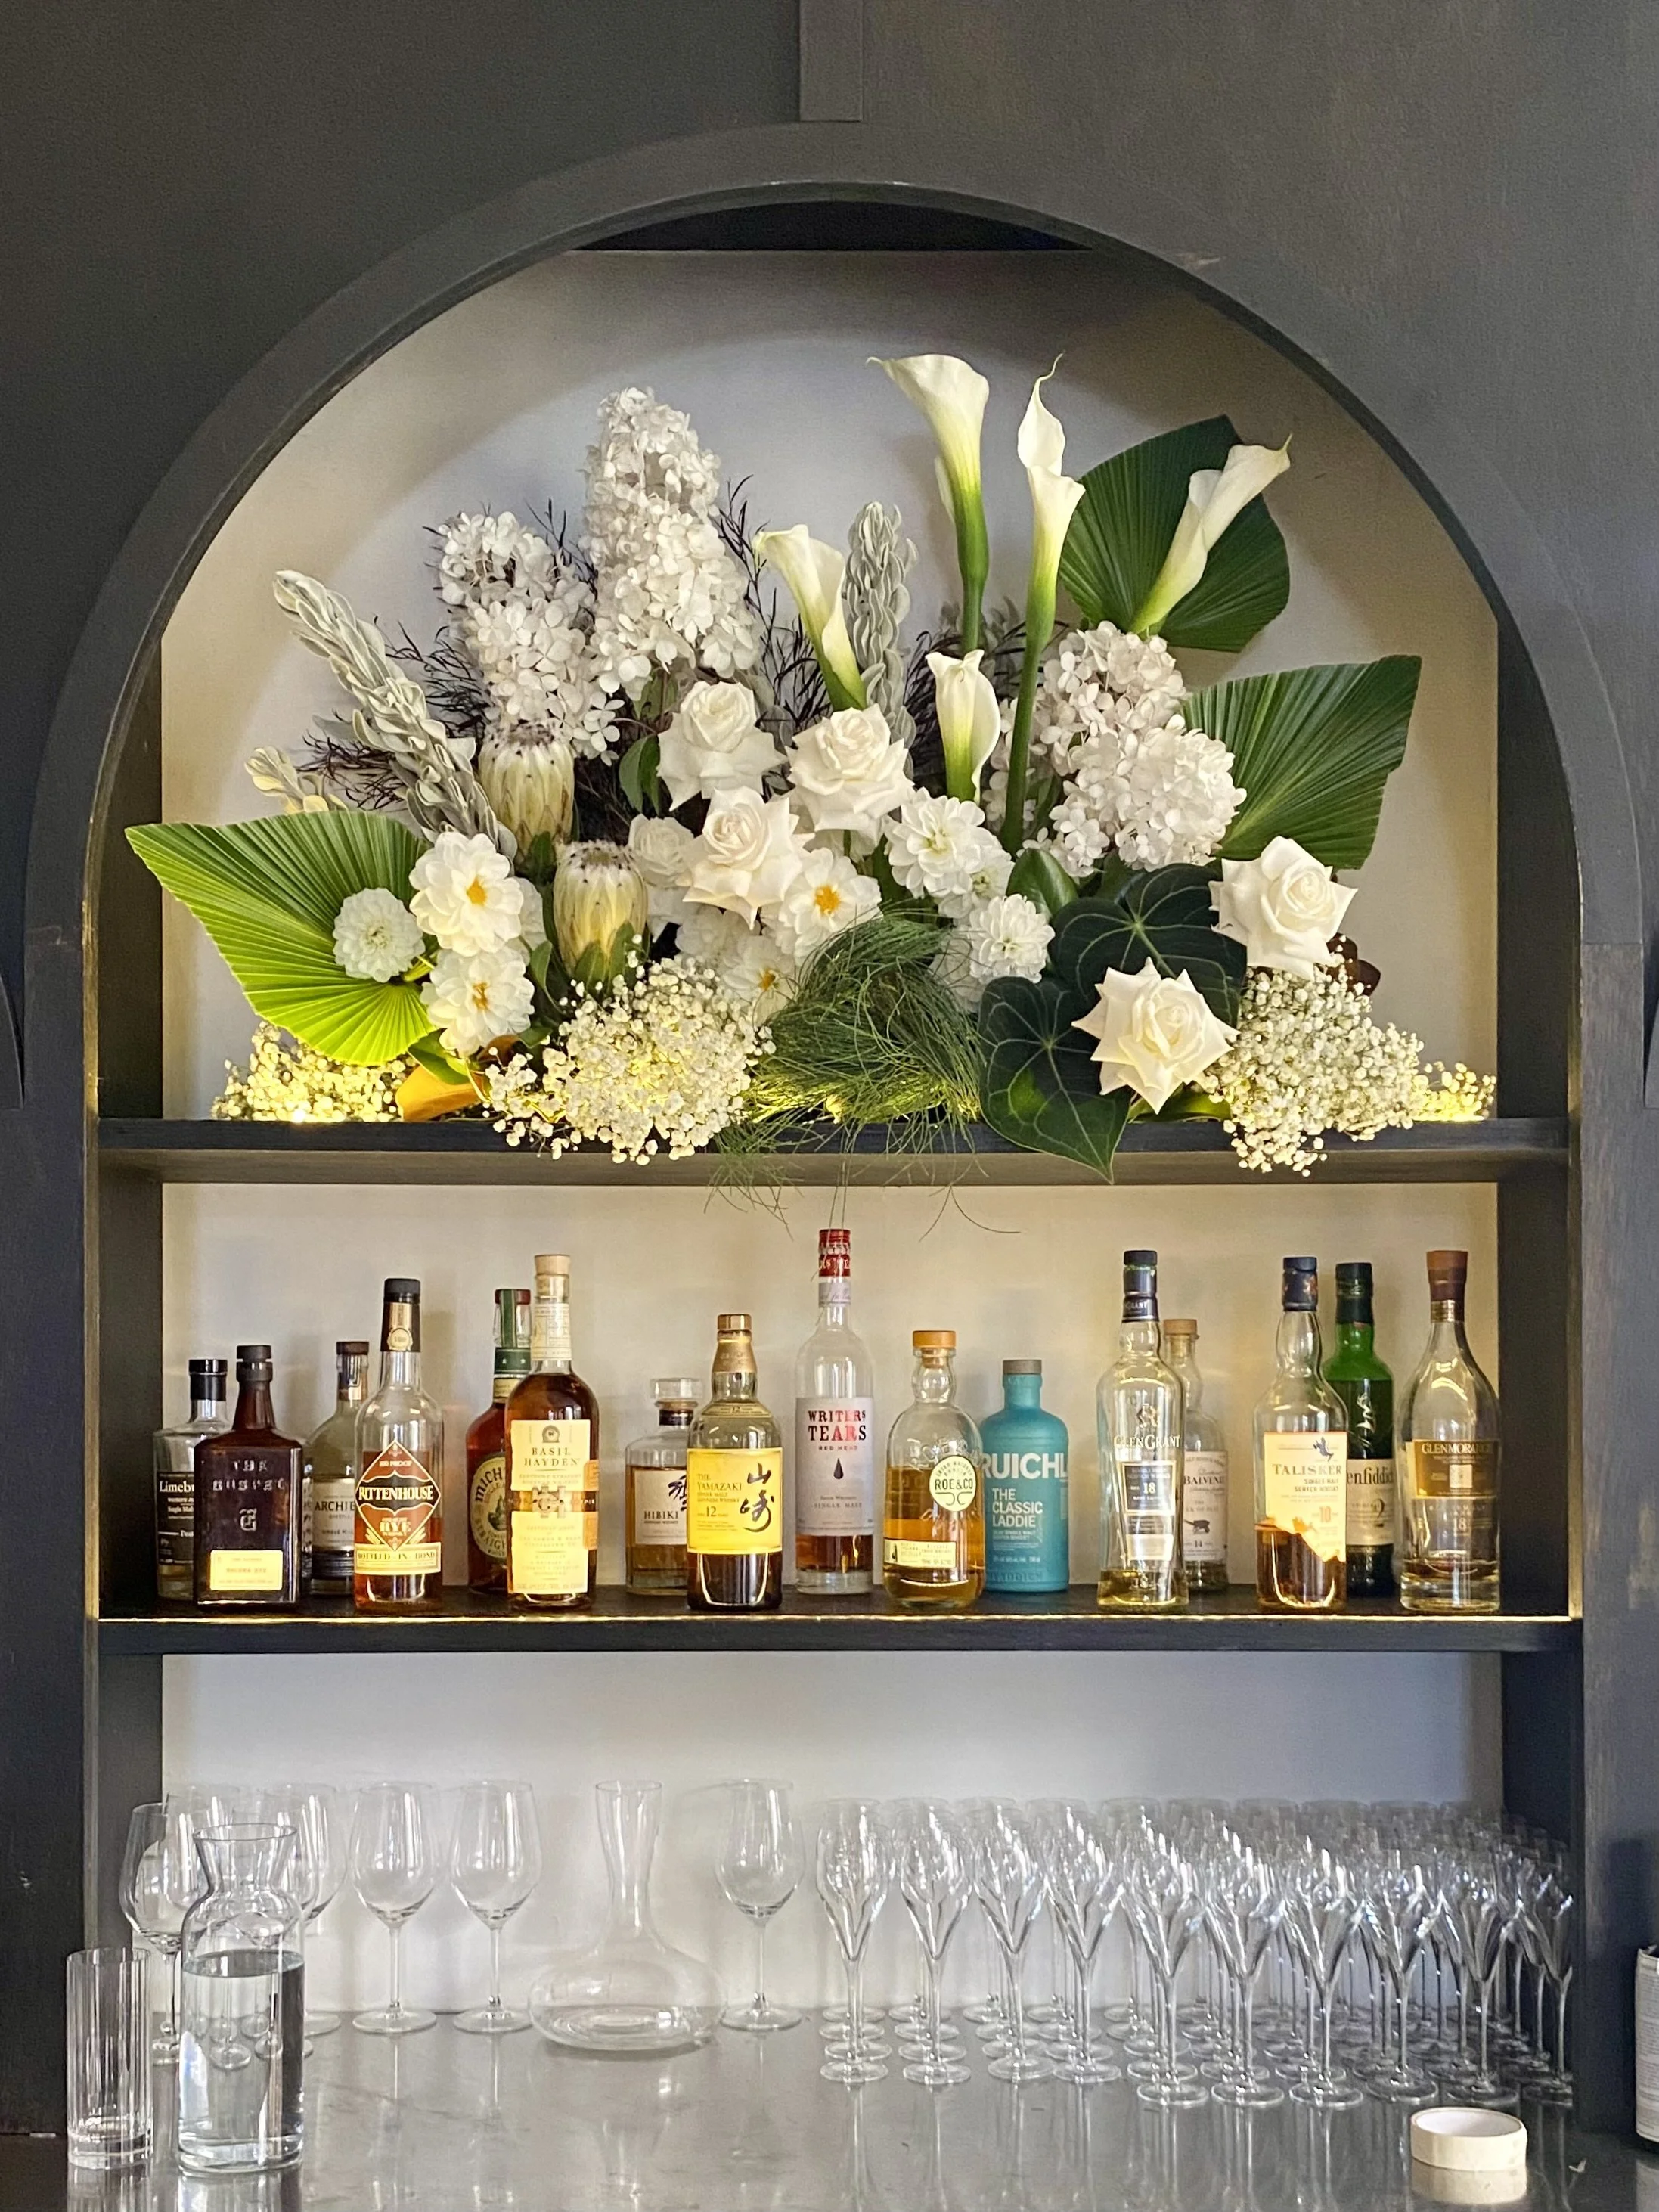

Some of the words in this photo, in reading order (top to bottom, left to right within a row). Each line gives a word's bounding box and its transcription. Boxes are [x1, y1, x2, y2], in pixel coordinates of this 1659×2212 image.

[808, 1410, 866, 1422] WRITERS
[808, 1425, 867, 1441] TEARS
[532, 1447, 571, 1456] BASIL
[524, 1457, 578, 1466] HAYDEN
[1272, 1463, 1342, 1475] TALISKER
[697, 1482, 742, 1491] YAMAZAKI
[1143, 1482, 1156, 1494] 18
[358, 1485, 434, 1501] RITTENHOUSE
[992, 1488, 1016, 1501] THE
[706, 1506, 717, 1517] 12
[992, 1501, 1043, 1515] CLASSIC
[643, 1510, 679, 1519] HIBIKI
[1319, 1506, 1332, 1523] 10
[992, 1515, 1036, 1528] LADDIE
[358, 1552, 391, 1561] BOTTLED
[415, 1551, 436, 1560] BOND
